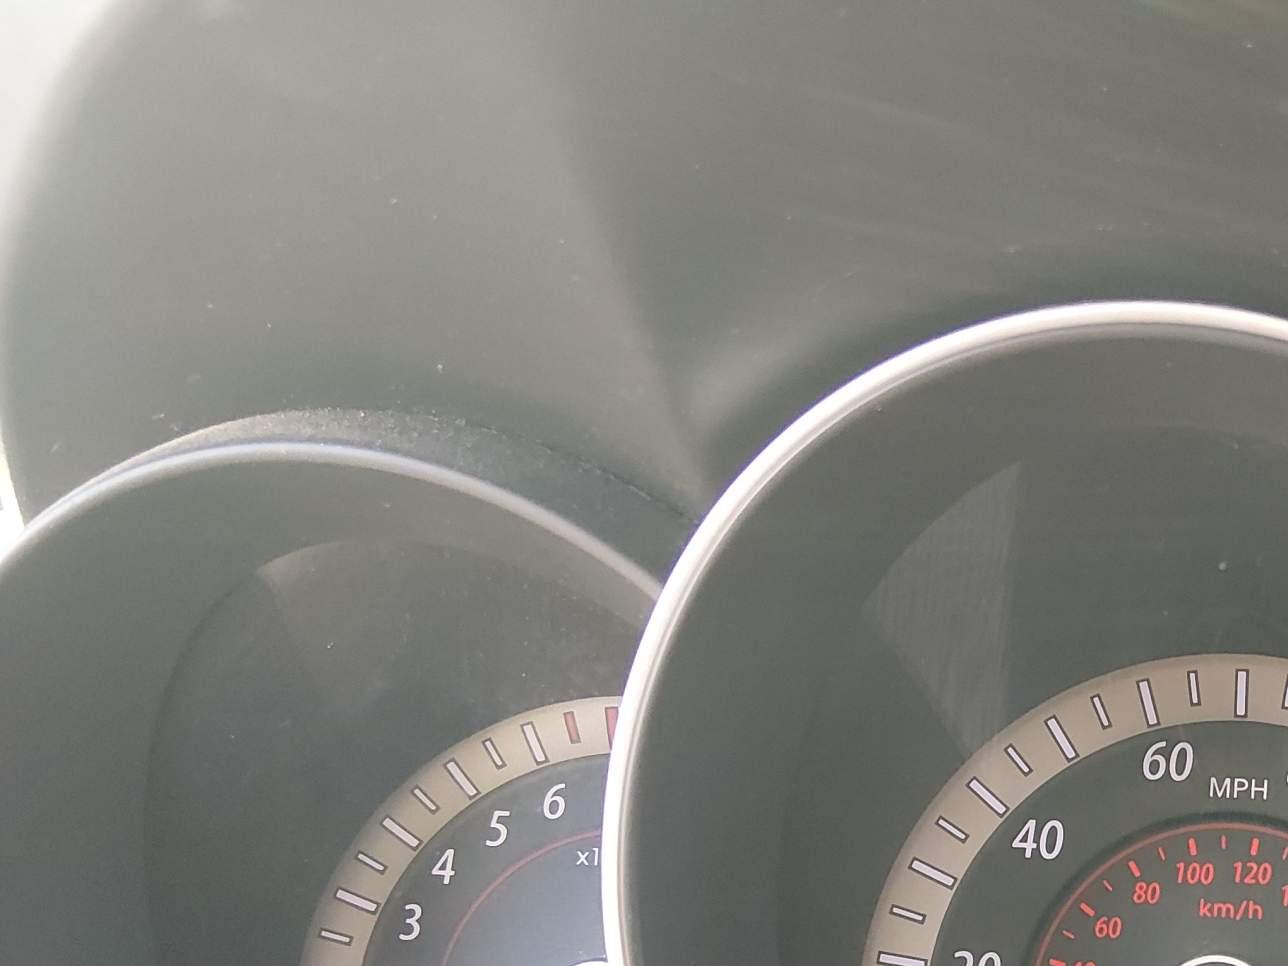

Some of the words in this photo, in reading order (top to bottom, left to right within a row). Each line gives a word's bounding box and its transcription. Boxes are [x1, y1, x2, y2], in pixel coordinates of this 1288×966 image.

[1142, 741, 1193, 783] 60
[543, 783, 566, 819] 6
[1208, 776, 1269, 801] MPH
[486, 810, 511, 847] 5
[1012, 819, 1064, 859] 40
[432, 849, 456, 884] 4
[1175, 861, 1214, 886] 100
[1233, 861, 1272, 885] 120
[1133, 882, 1160, 904] 80
[399, 904, 422, 941] 3
[1199, 899, 1263, 922] km/h
[1094, 917, 1122, 939] 60
